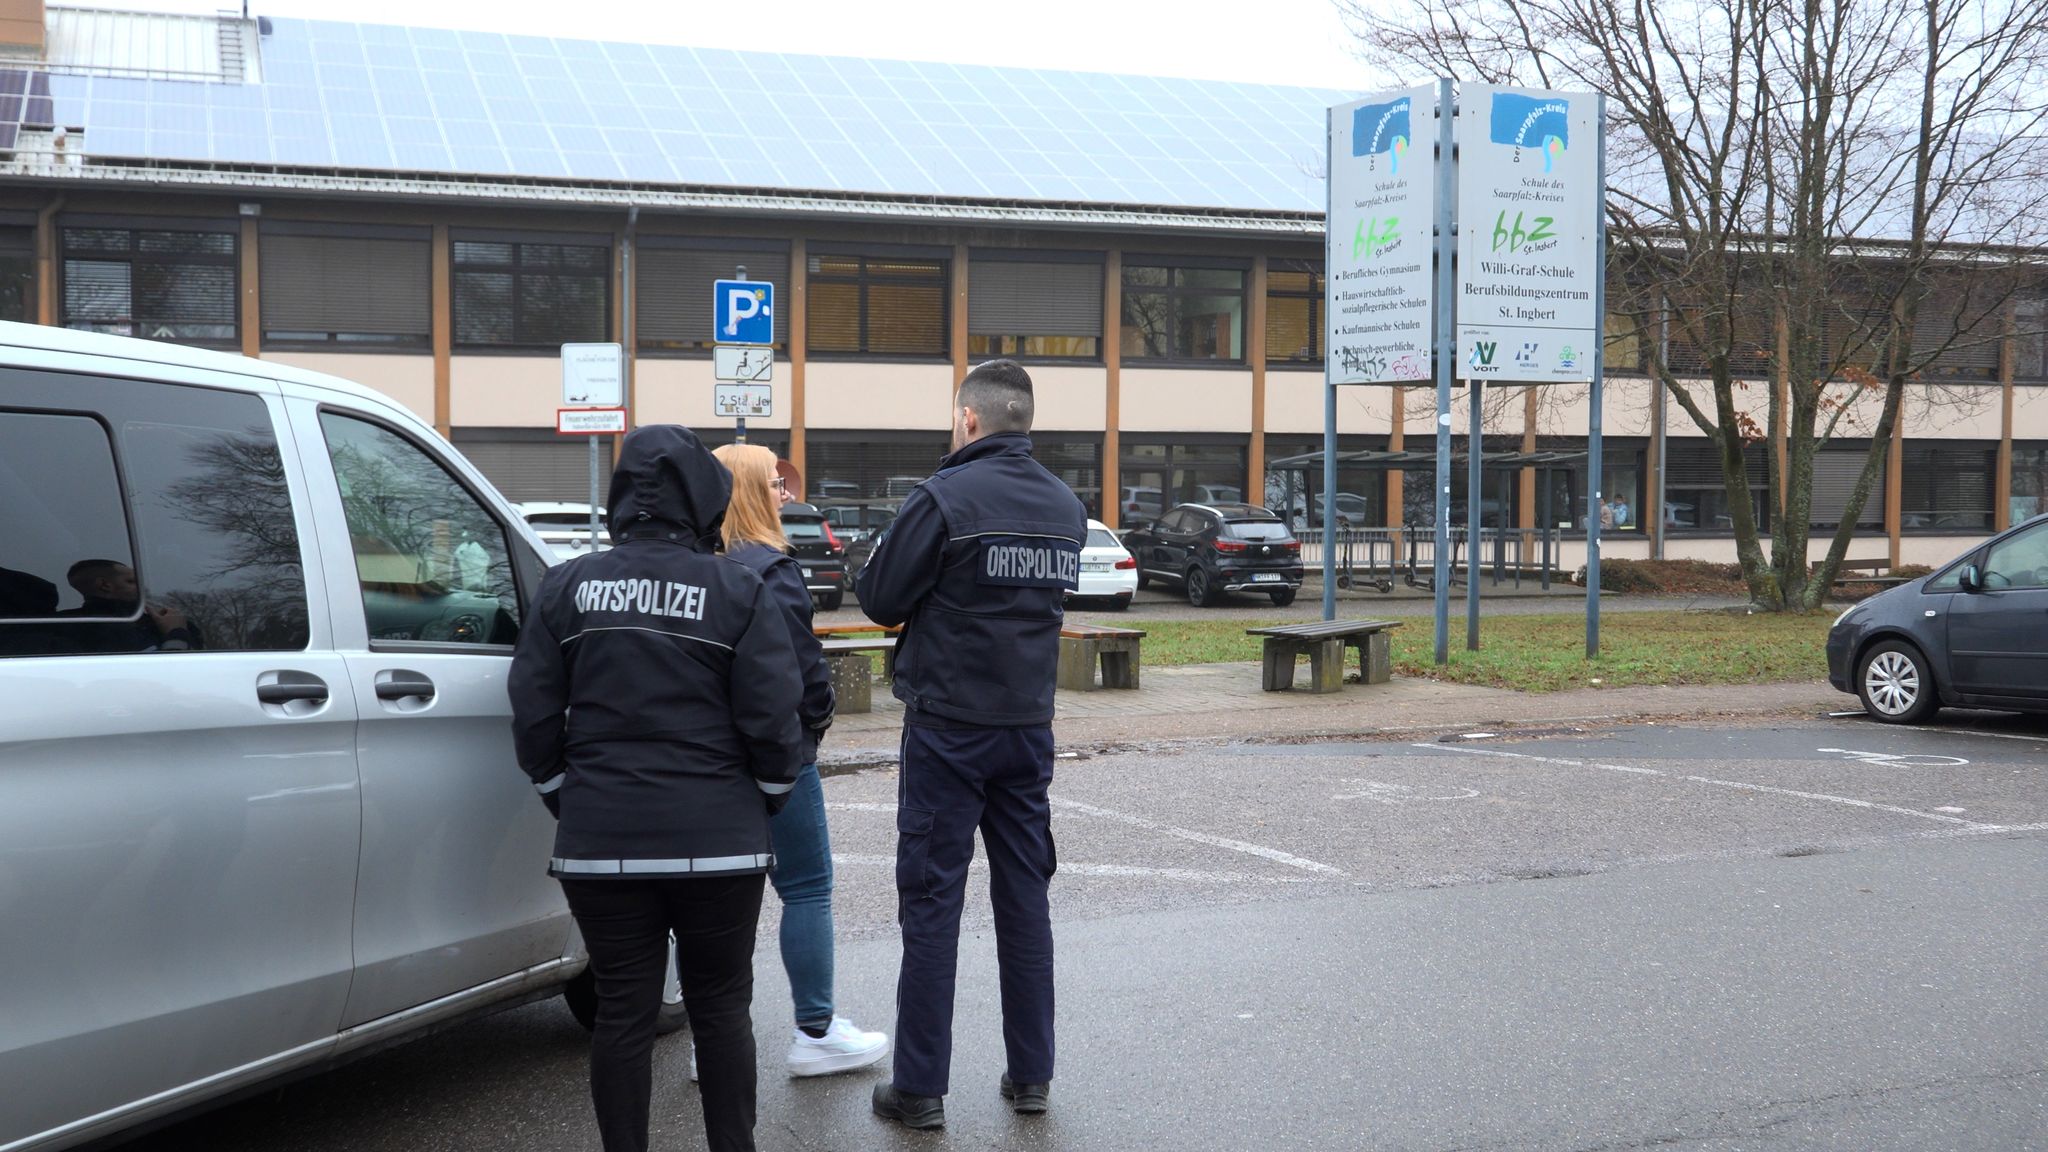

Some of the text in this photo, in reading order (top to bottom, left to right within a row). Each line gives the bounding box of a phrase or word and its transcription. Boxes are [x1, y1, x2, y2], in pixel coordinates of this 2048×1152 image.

[1515, 103, 1566, 144] Saarpfalz-Kreis
[1374, 179, 1408, 192] Schule des
[1521, 177, 1565, 189] Schule des
[1353, 193, 1407, 209] Saarpfalz-Kreises
[1492, 189, 1565, 203] Saarpfalz-Kreises
[1523, 239, 1558, 256] St. Ingbert
[1342, 262, 1422, 281] Berufliches Gymnasium
[1481, 261, 1575, 279] Willi-Graf-Schule
[1342, 285, 1406, 301] Hauswirtschaftlich-
[1464, 282, 1589, 301] Berufsbildungszentrum
[728, 289, 760, 335] P
[1341, 297, 1427, 315] sozialpflegerische Schulen
[1498, 306, 1556, 321] St. Ingbert
[1393, 319, 1421, 331] Schulen
[986, 545, 1078, 584] ORTSPOLIZEI
[575, 578, 707, 621] ORTSPOLIZEI
